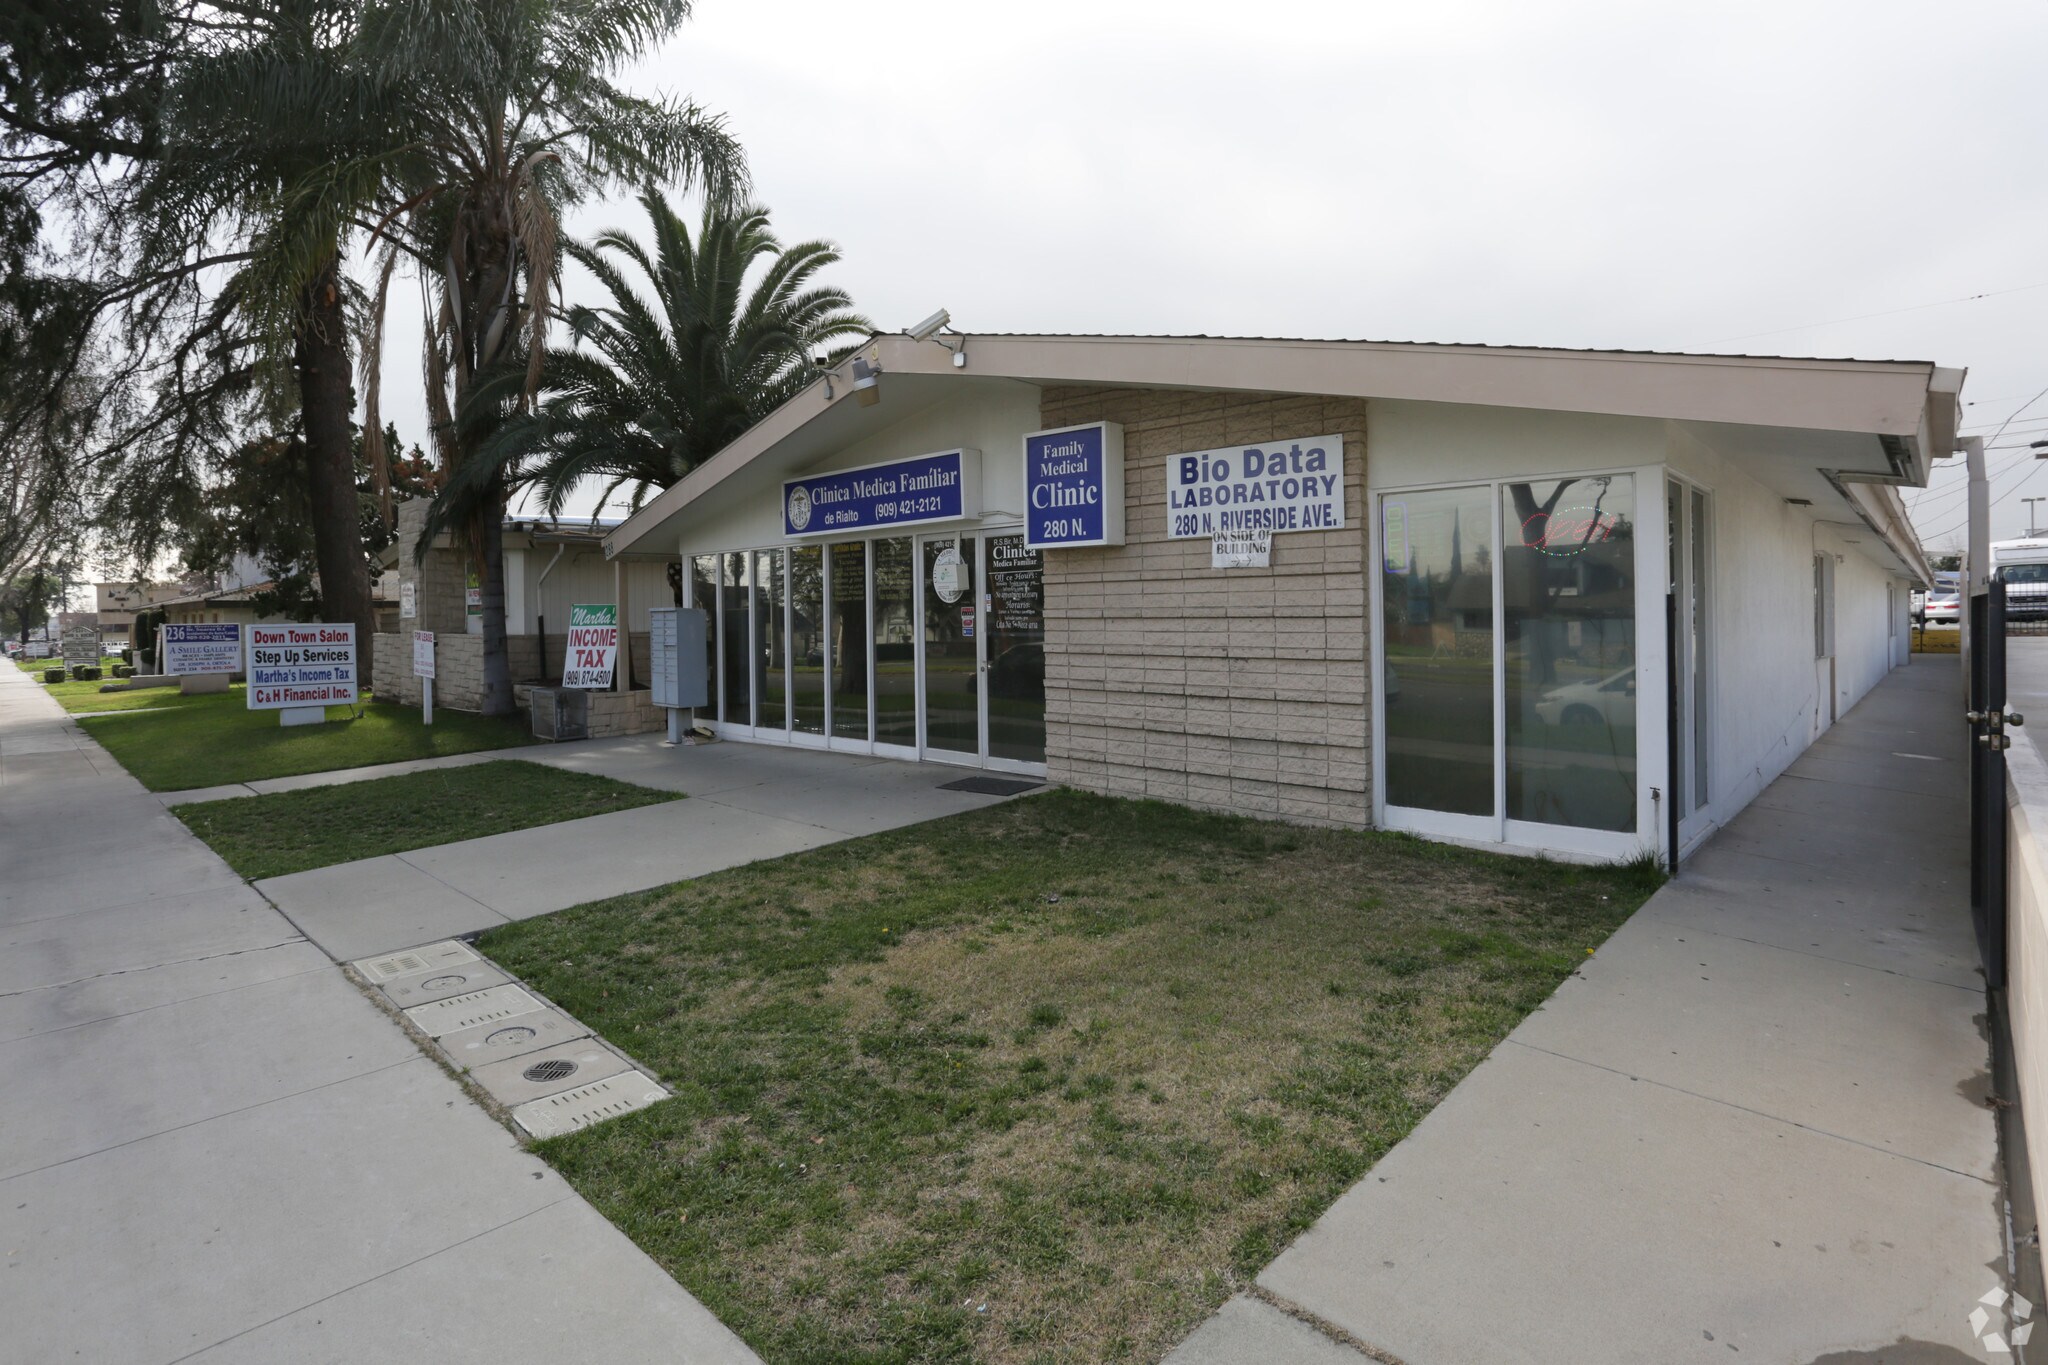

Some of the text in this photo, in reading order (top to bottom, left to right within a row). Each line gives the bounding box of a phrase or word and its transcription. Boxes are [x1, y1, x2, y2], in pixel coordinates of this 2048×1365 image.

[1043, 441, 1084, 458] Family
[1040, 458, 1088, 477] Medical
[1180, 444, 1326, 485] Bio Data
[812, 467, 958, 506] Clinica Medica Famíliar
[1032, 479, 1098, 509] Clinic
[1171, 474, 1337, 510] LABORATORY
[824, 496, 942, 525] de Rialto (909) 421-2121
[1044, 518, 1086, 538] 280 N.
[1175, 503, 1337, 536] 280 N. RIVERSIDE AVE.
[1213, 532, 1228, 542] ON
[1258, 530, 1271, 540] OF
[993, 544, 1036, 560] Clinica
[1217, 542, 1266, 554] BUILDING
[572, 607, 616, 625] Martha's
[167, 627, 185, 640] 236
[254, 630, 348, 644] Down Town Salon
[422, 633, 432, 642] LEASE
[569, 629, 617, 647] INCOME
[255, 649, 349, 666] Step Up Services
[576, 650, 606, 668] TAX
[256, 668, 350, 683] Martha's Income Tax
[564, 670, 610, 686] (909) 874-4500
[256, 686, 351, 703] C & H Financial Inc.
